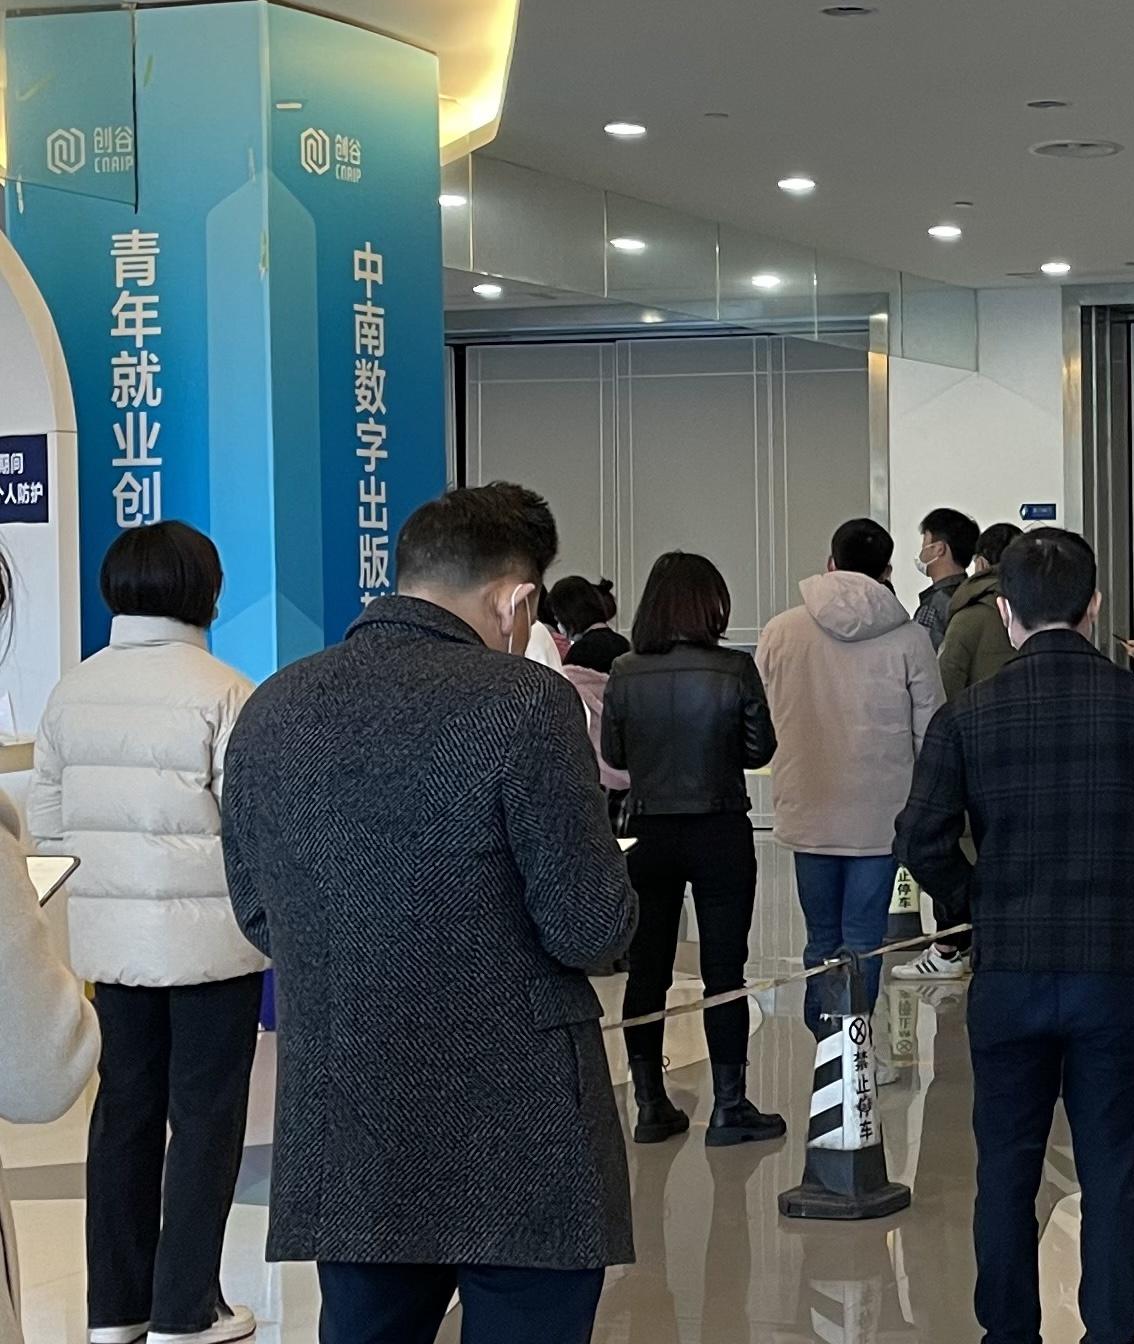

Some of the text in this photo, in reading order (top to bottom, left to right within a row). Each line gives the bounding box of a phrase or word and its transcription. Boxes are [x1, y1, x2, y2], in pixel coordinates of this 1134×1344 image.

[94, 126, 133, 153] 创谷
[335, 134, 361, 165] 创谷
[110, 229, 162, 528] 青年就业创
[352, 242, 396, 606] 中南数字出版
[897, 865, 912, 908] 止停车
[853, 1050, 873, 1141] 禁止停车
